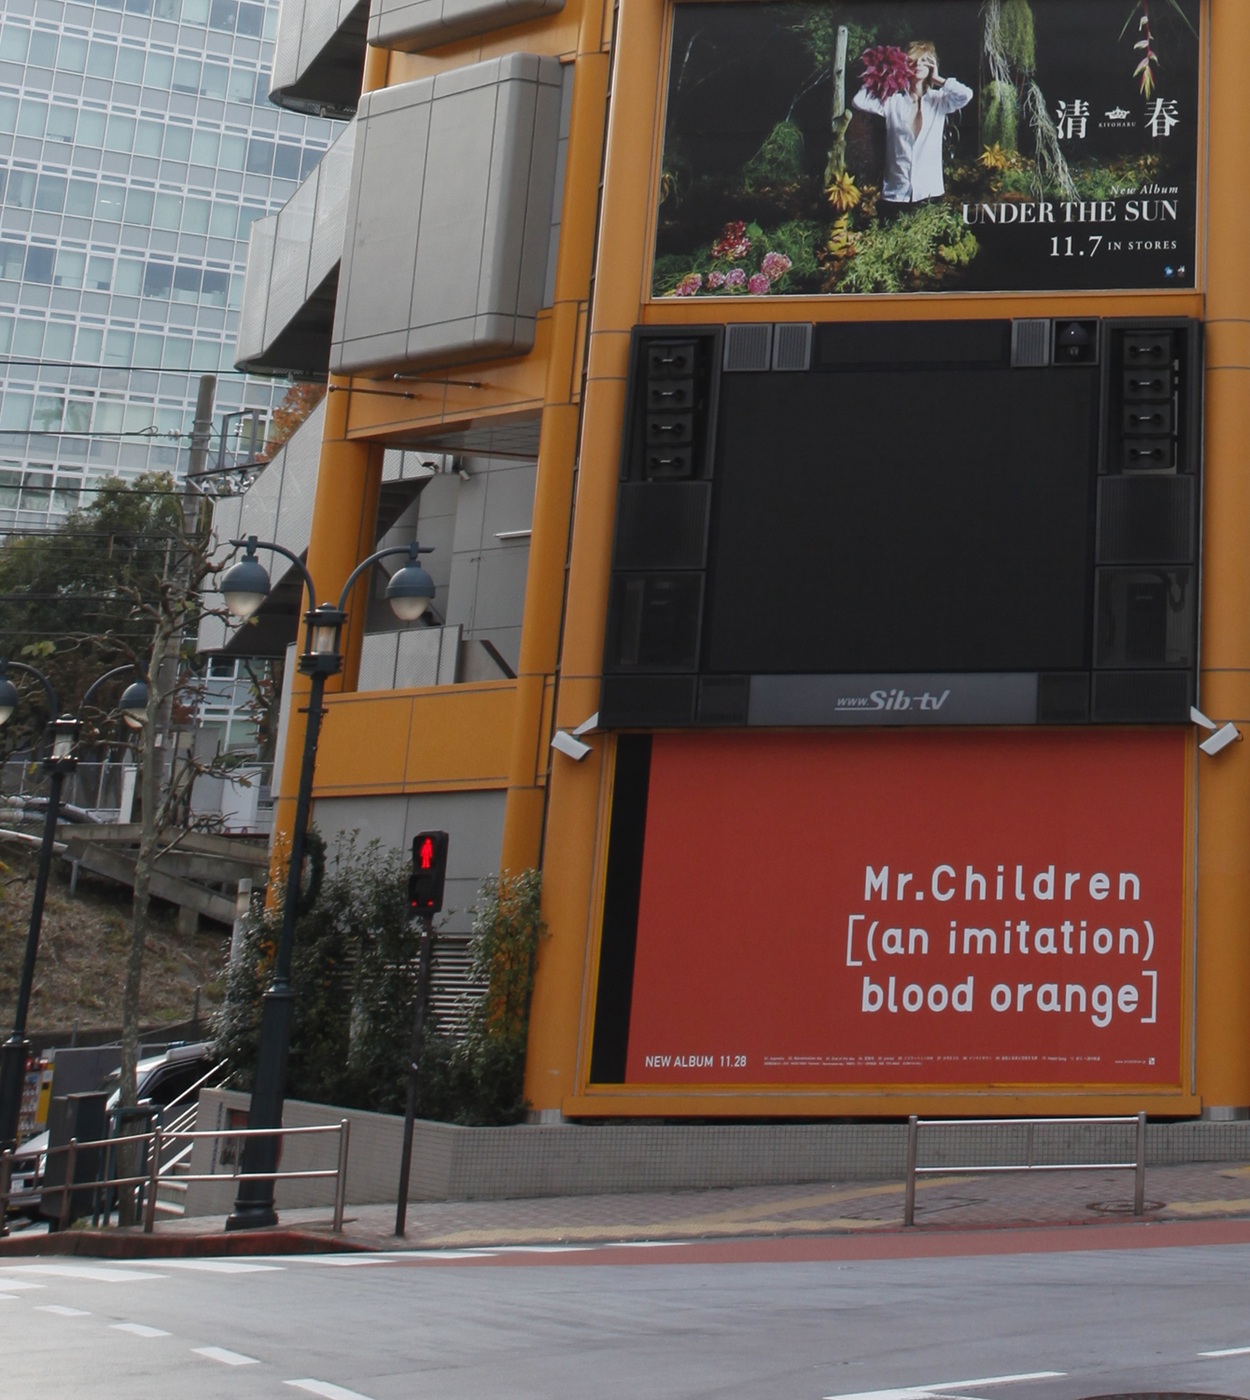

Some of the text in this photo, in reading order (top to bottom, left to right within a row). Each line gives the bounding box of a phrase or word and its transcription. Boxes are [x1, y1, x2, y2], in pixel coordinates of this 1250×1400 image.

[1056, 97, 1180, 139] 清 春
[1110, 184, 1178, 195] New Album
[962, 200, 1178, 225] UNDER THE SUN
[1050, 235, 1177, 257] 11.7 IN STORES
[864, 865, 1141, 902] Mr.Children
[846, 915, 1156, 967] [(an imitation)
[861, 971, 1158, 1027] blood orange]
[645, 1055, 747, 1068] NEW ALBUM 11.28
